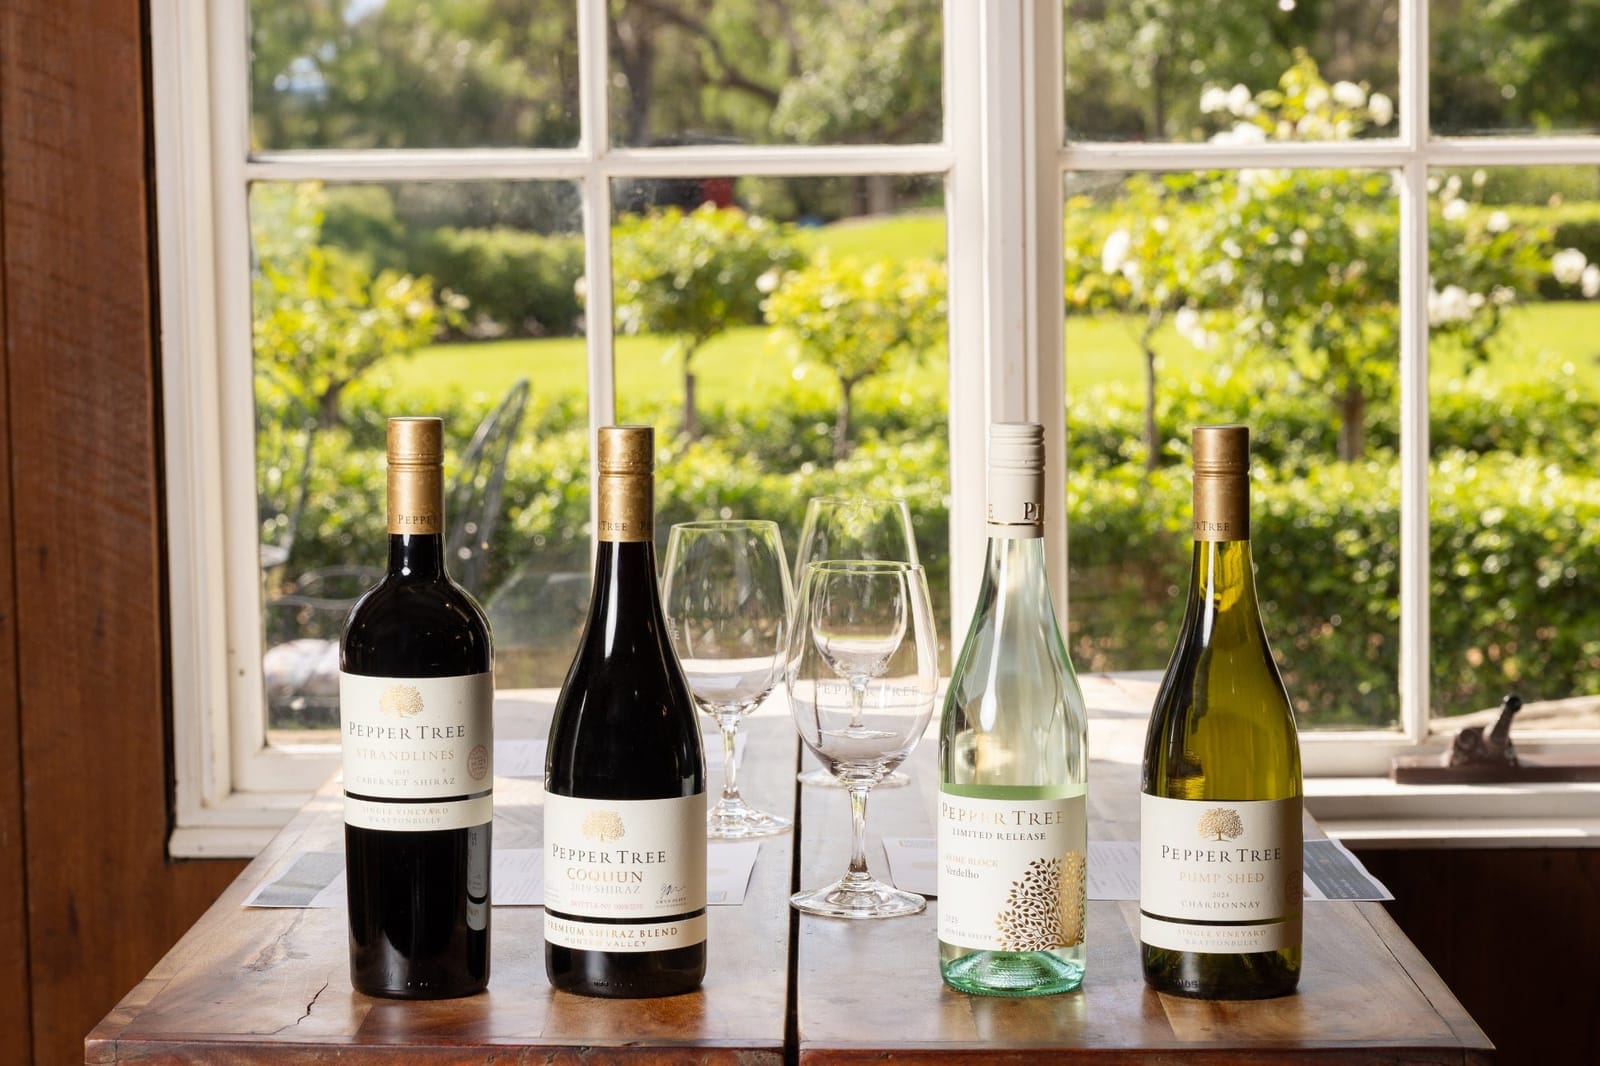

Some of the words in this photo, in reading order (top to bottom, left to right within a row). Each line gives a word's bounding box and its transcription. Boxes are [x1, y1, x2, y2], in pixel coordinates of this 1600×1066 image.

[398, 514, 436, 525] PEPPE
[600, 520, 628, 531] TREE
[1201, 520, 1229, 531] TREE
[815, 684, 875, 697] PEPPR
[349, 721, 412, 740] PEPPER
[416, 725, 465, 740] TREE
[356, 748, 455, 761] STRANDLINES
[356, 776, 408, 787] CABERNET
[414, 777, 456, 787] SHIRAZ
[396, 808, 449, 816] VINEYARD
[942, 801, 1007, 826] PEPPER
[1012, 810, 1065, 826] TREE
[952, 827, 993, 840] LIMITED
[996, 832, 1047, 841] RELEASE
[552, 843, 612, 864] PEPPER
[616, 850, 667, 864] TREE
[1161, 844, 1232, 863] PEPPER
[1236, 847, 1281, 862] TREE
[567, 867, 644, 883] COQUUN
[945, 864, 980, 879] Verdelho
[1179, 871, 1221, 884] PUMP
[1227, 872, 1265, 884] SHED
[594, 885, 641, 895] SHIRAZ
[1180, 900, 1261, 910] CHARDONNAY
[547, 920, 585, 936] PREMIUM
[588, 928, 634, 939] SHIRAZ
[639, 926, 679, 938] BLEND
[1215, 929, 1266, 938] VINEYARD
